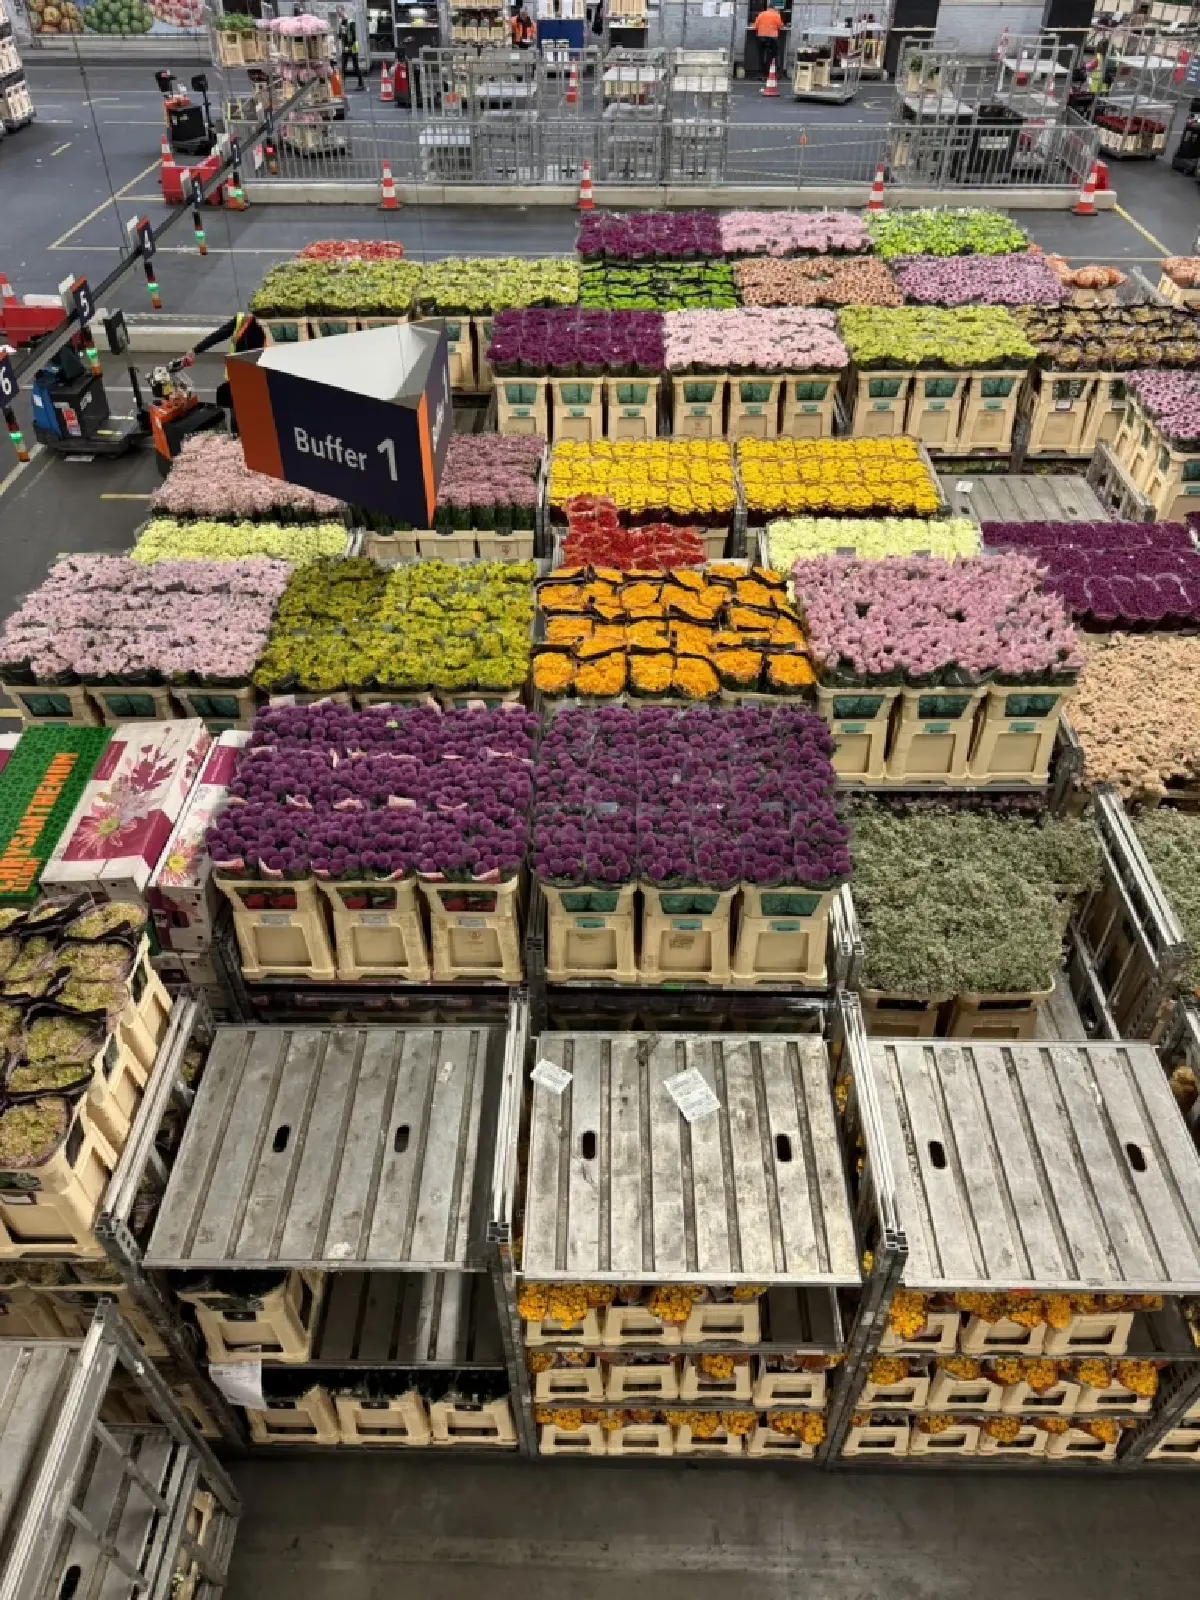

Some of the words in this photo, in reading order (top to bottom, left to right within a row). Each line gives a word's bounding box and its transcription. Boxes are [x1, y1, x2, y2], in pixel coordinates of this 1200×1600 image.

[80, 290, 90, 317] 5
[0, 366, 12, 396] 6
[294, 426, 367, 471] Buffer
[377, 437, 398, 481] 1
